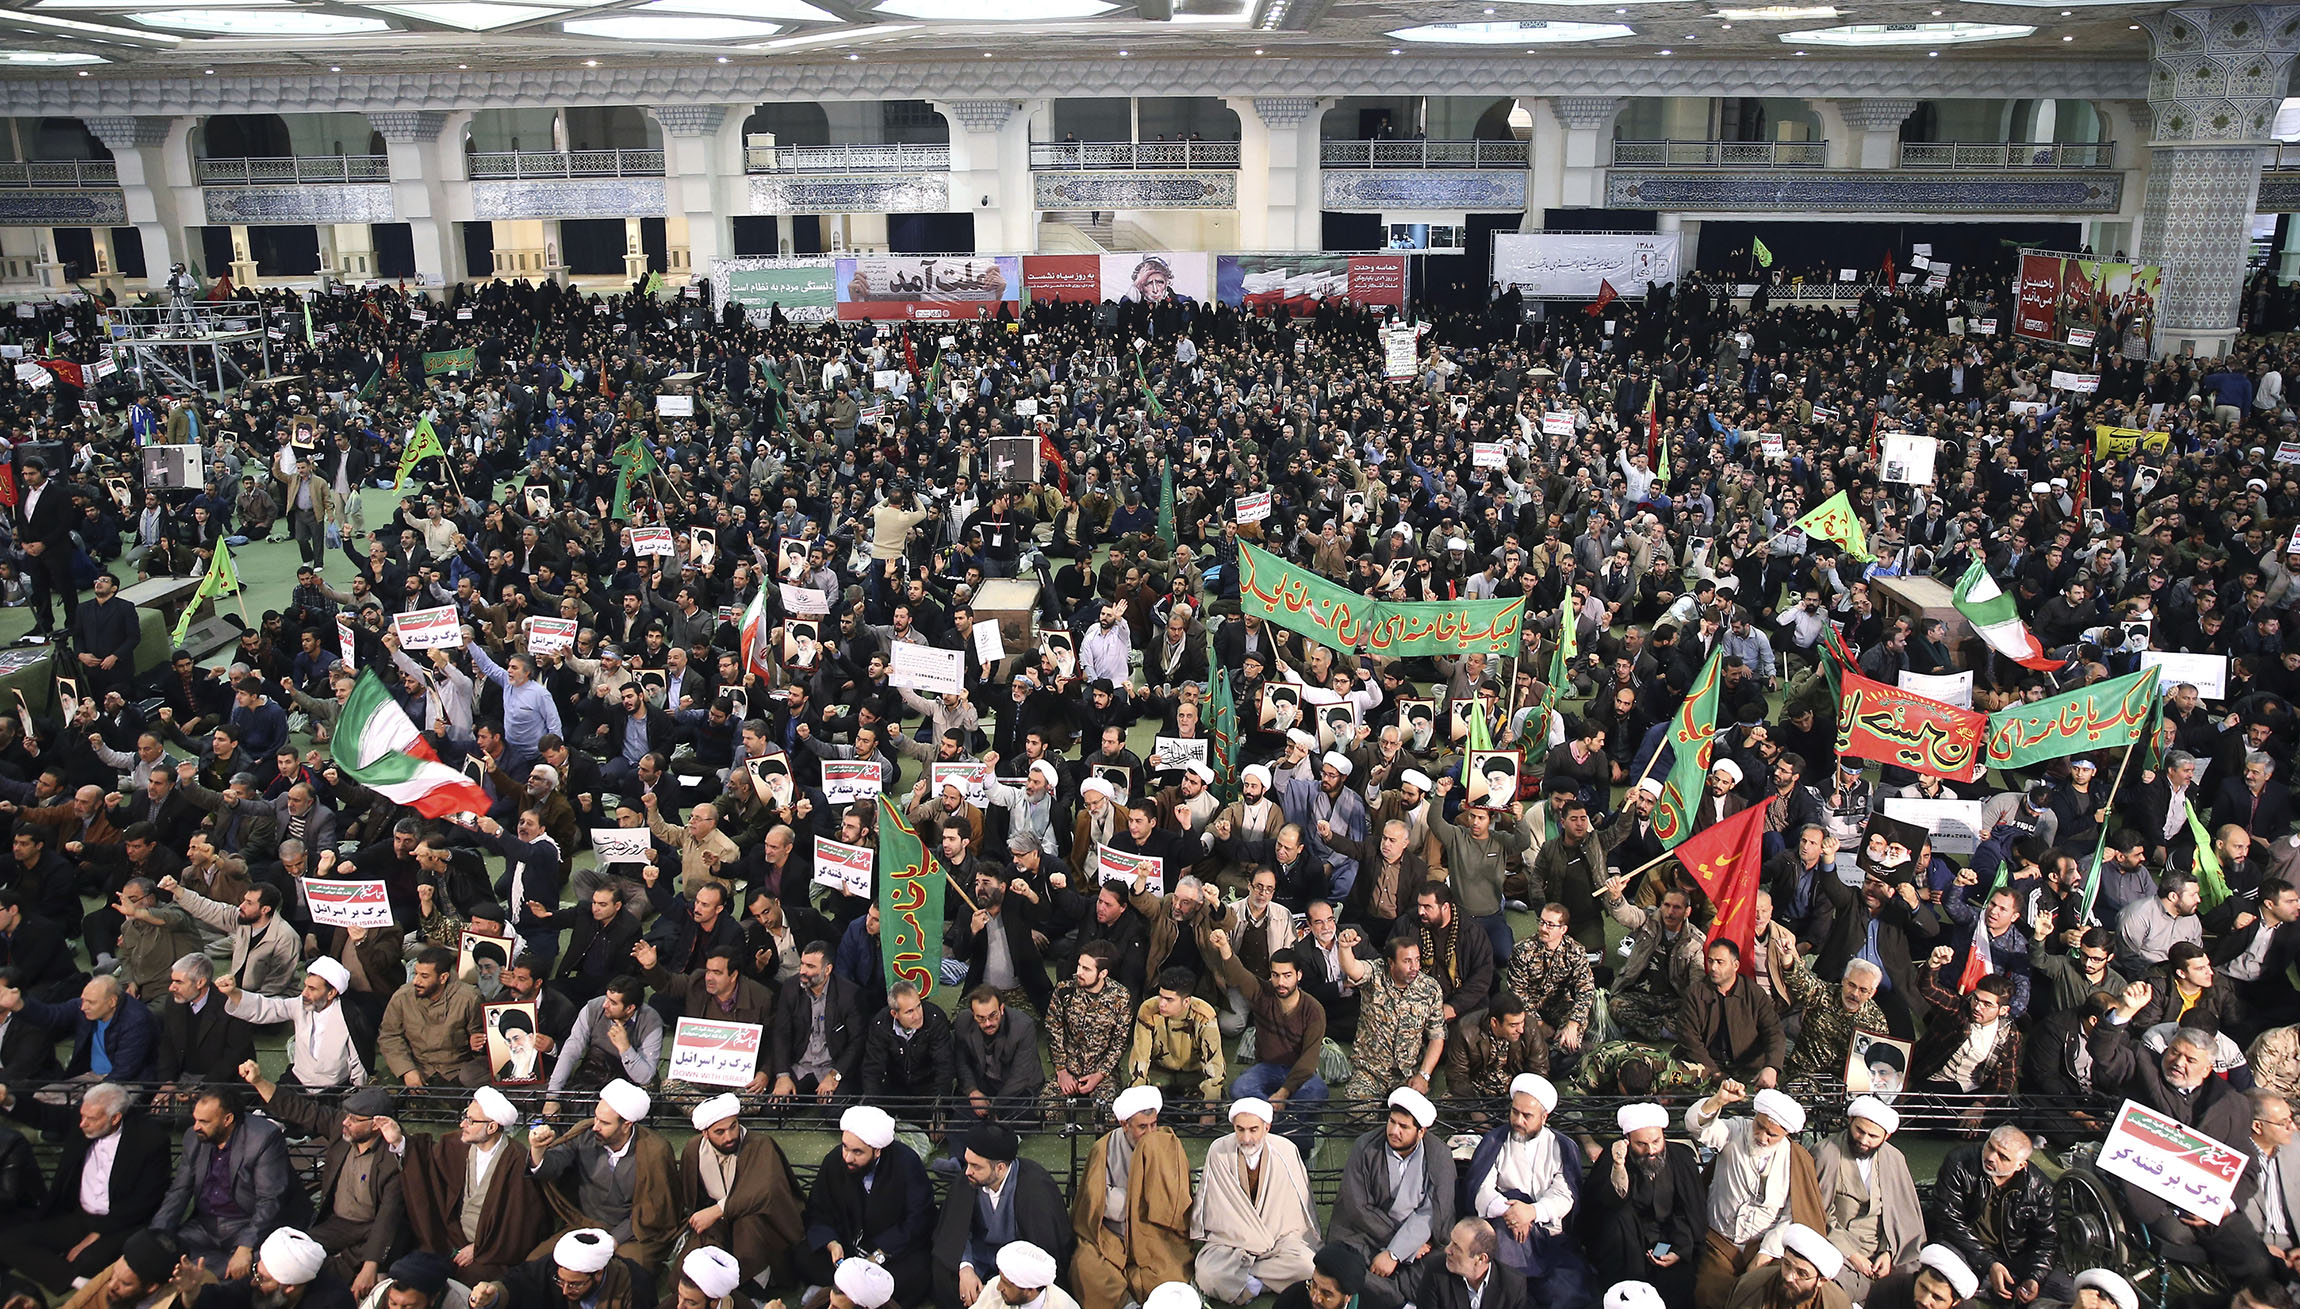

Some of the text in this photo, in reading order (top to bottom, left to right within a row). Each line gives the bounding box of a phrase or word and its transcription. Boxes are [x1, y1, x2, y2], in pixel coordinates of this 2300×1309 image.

[1354, 264, 1374, 272] وحدت
[1636, 269, 1650, 277] دی
[890, 259, 938, 293] آمد
[1028, 272, 1095, 281] به روز سیاه نشست
[732, 280, 834, 293] دلبستگی مردم به نظام است
[1458, 610, 1470, 648] یا
[1459, 596, 1526, 650] لبیک
[316, 916, 338, 924] DOWN
[672, 1069, 748, 1083] DOWN WITH ISRAEL
[2132, 1156, 2163, 1175] فتنه
[2162, 1176, 2180, 1189] بر
